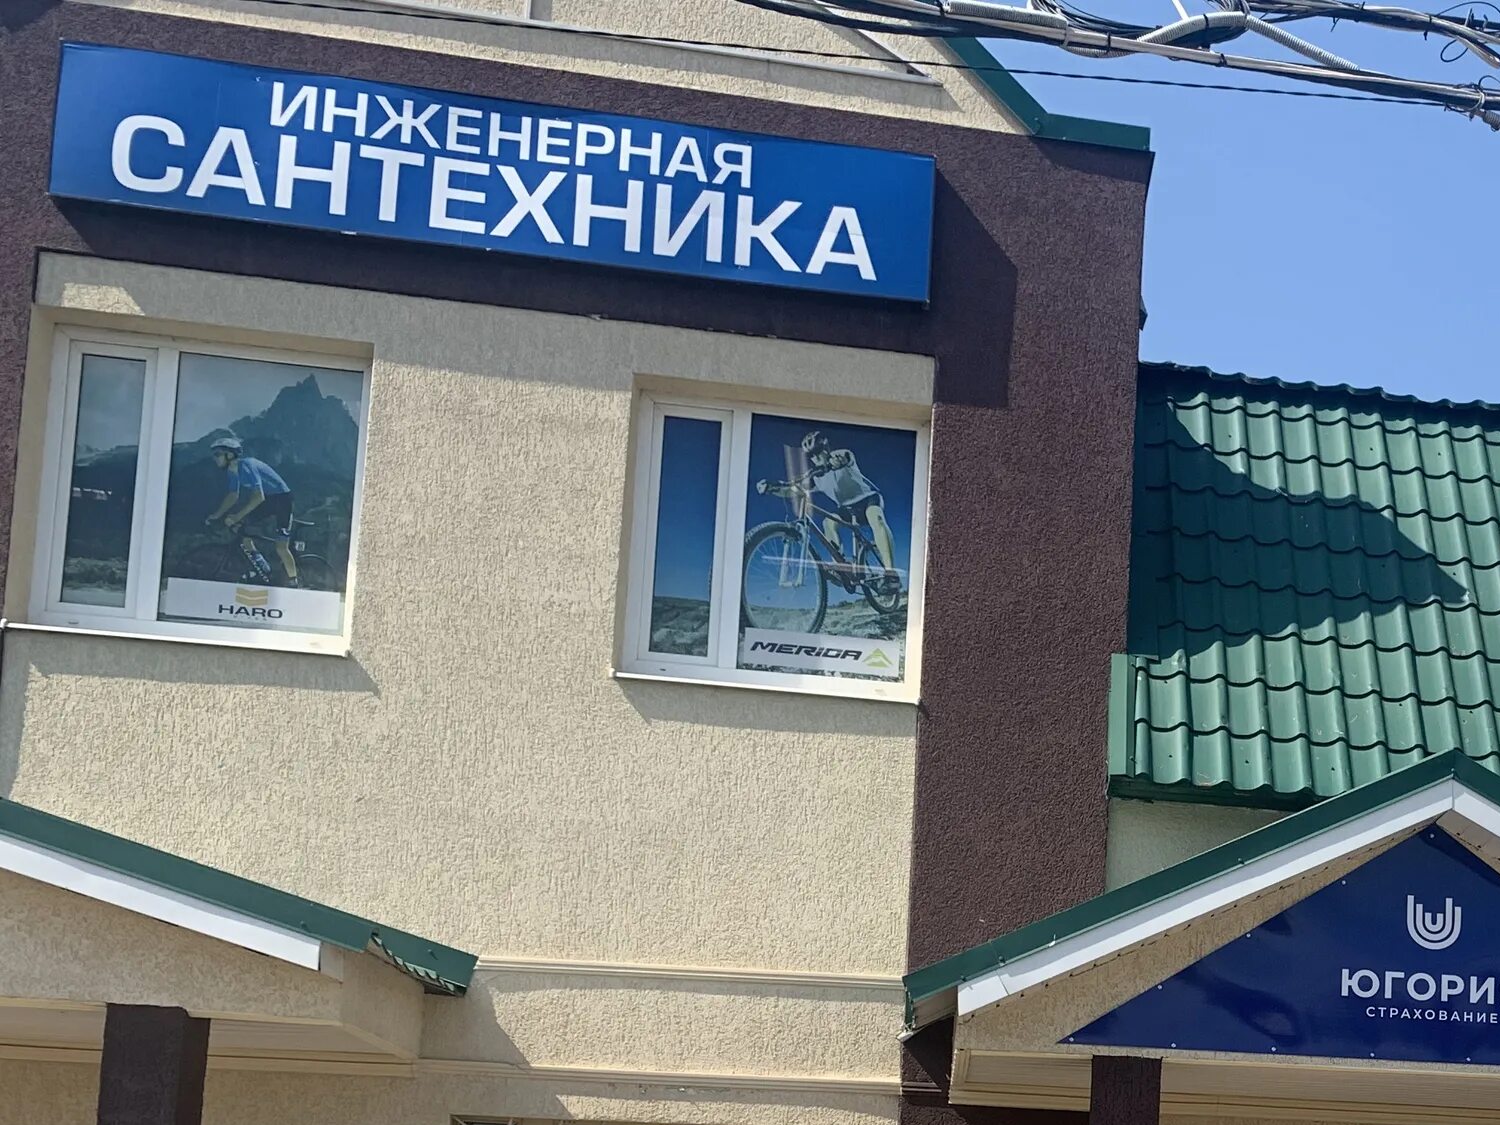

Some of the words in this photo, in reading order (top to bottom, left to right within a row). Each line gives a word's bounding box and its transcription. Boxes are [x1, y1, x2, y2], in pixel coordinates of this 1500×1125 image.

[270, 82, 752, 188] ИНЖЕНЕРНАЯ
[112, 115, 877, 281] САНТЕХНИКА
[218, 604, 283, 619] HARO
[750, 641, 863, 661] MERIDA
[1366, 1006, 1498, 1024] СТРАХОВАНИЕ
